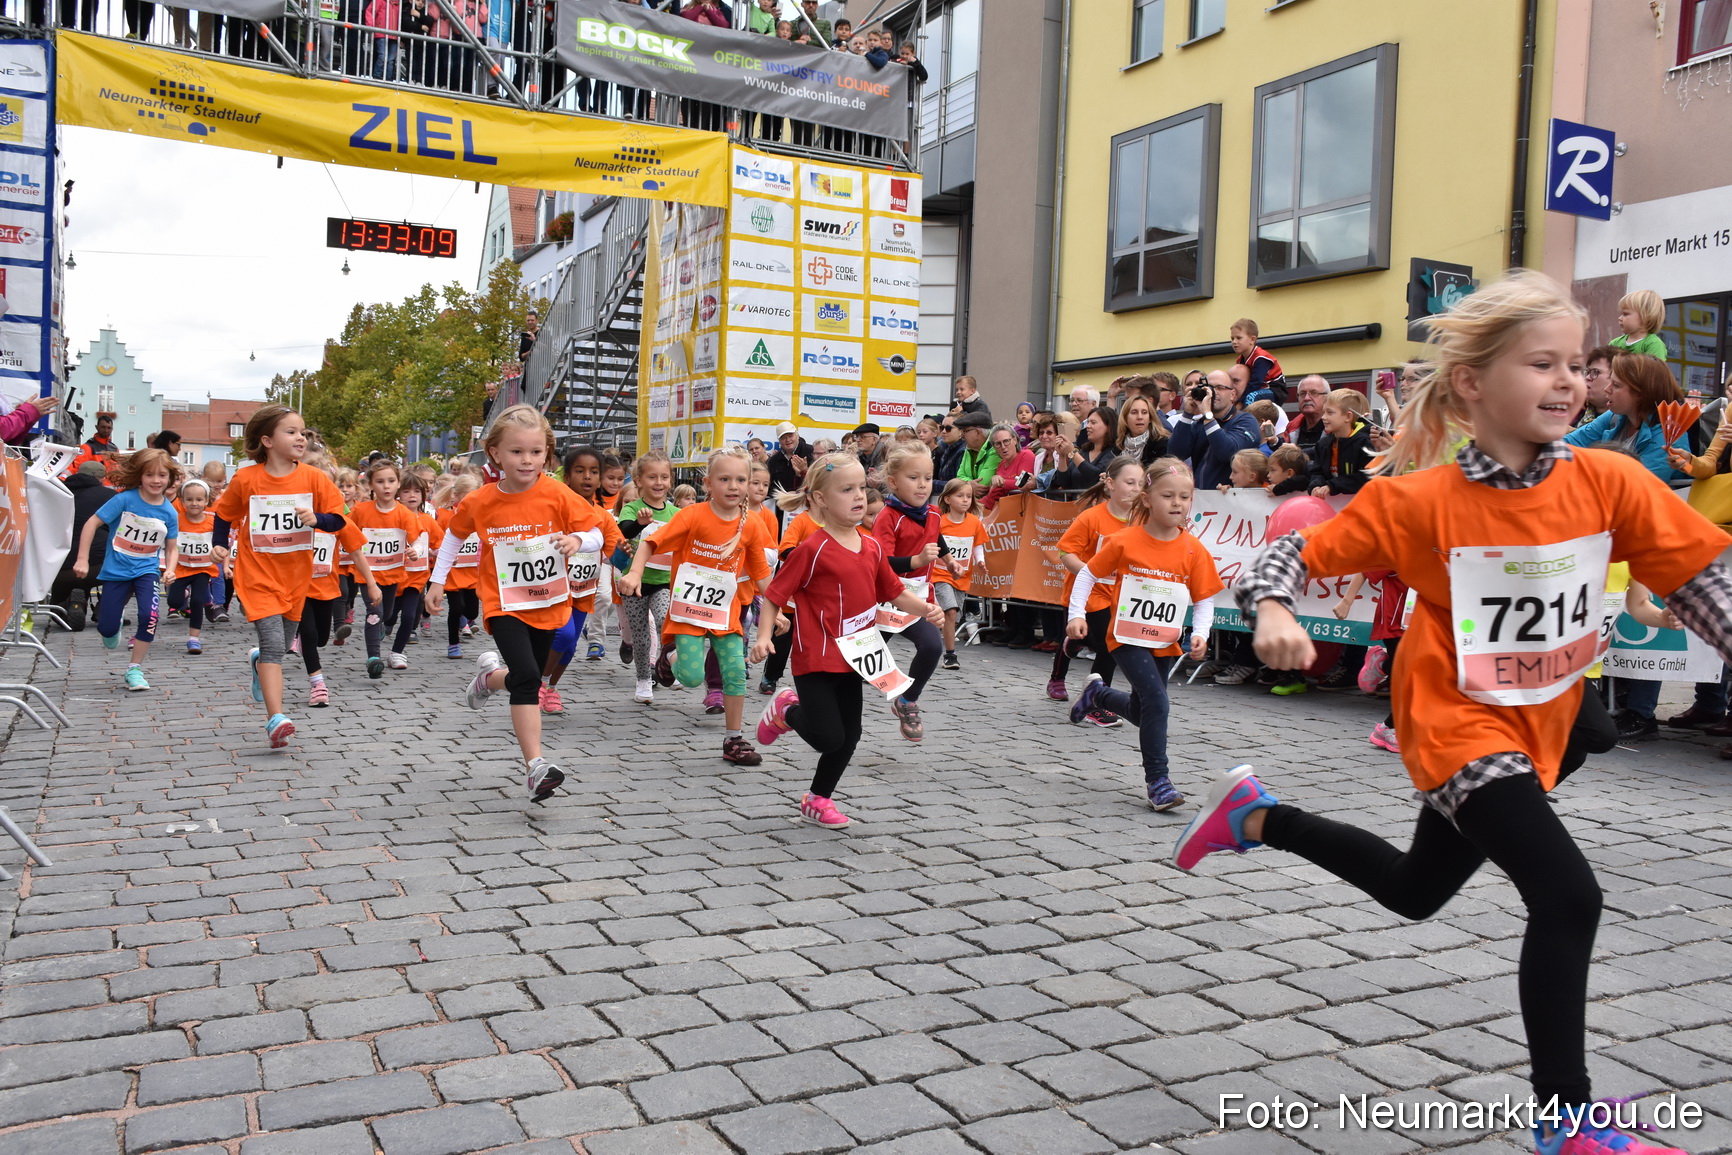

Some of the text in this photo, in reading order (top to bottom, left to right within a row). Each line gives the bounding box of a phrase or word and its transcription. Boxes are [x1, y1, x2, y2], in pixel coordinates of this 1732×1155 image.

[579, 19, 691, 63] BOCK
[576, 43, 698, 74] inspired by smart concepts
[713, 50, 891, 98] OFFICE INDUSTRY LOUNGE
[744, 75, 866, 111] www.bockonline.de
[99, 87, 262, 125] Neumarkter Stadtlauf
[349, 103, 498, 165] ZIEL
[574, 157, 700, 178] Neumarkter Stadtlauf
[764, 182, 791, 192] energie
[803, 231, 828, 239] stadtwerke
[804, 219, 841, 235] swn
[1609, 229, 1731, 263] Unterer Markt 15
[732, 260, 775, 272] RAIL.ONE
[835, 265, 854, 275] CODE
[835, 272, 858, 282] CLINIC
[747, 304, 791, 317] VARIOTEC
[832, 366, 860, 374] energie
[727, 397, 772, 406] RAIL.ONE
[870, 402, 908, 413] charivari
[124, 525, 159, 543] 7114
[486, 523, 532, 535] Neumarkter
[987, 520, 1018, 537] ODE
[272, 536, 293, 544] Emma
[368, 540, 400, 554] 7105
[459, 542, 478, 554] 255
[181, 543, 209, 554] 7153
[508, 556, 557, 583] 7032
[1128, 564, 1174, 578] Neumarkter
[1523, 554, 1576, 575] BOCK
[528, 587, 549, 596] Paula
[683, 581, 726, 607] 7132
[146, 580, 160, 635] AWESOME
[685, 606, 713, 618] Franziska
[1129, 597, 1177, 623] 7040
[1481, 582, 1589, 643] 7214
[1141, 627, 1159, 636] Frida
[1313, 622, 1330, 636] 63
[1333, 625, 1351, 638] 52
[852, 648, 883, 676] 707
[1495, 647, 1578, 685] EMILY
[1612, 655, 1655, 670] Service
[1658, 658, 1687, 671] GmbH
[876, 680, 888, 690] Leni
